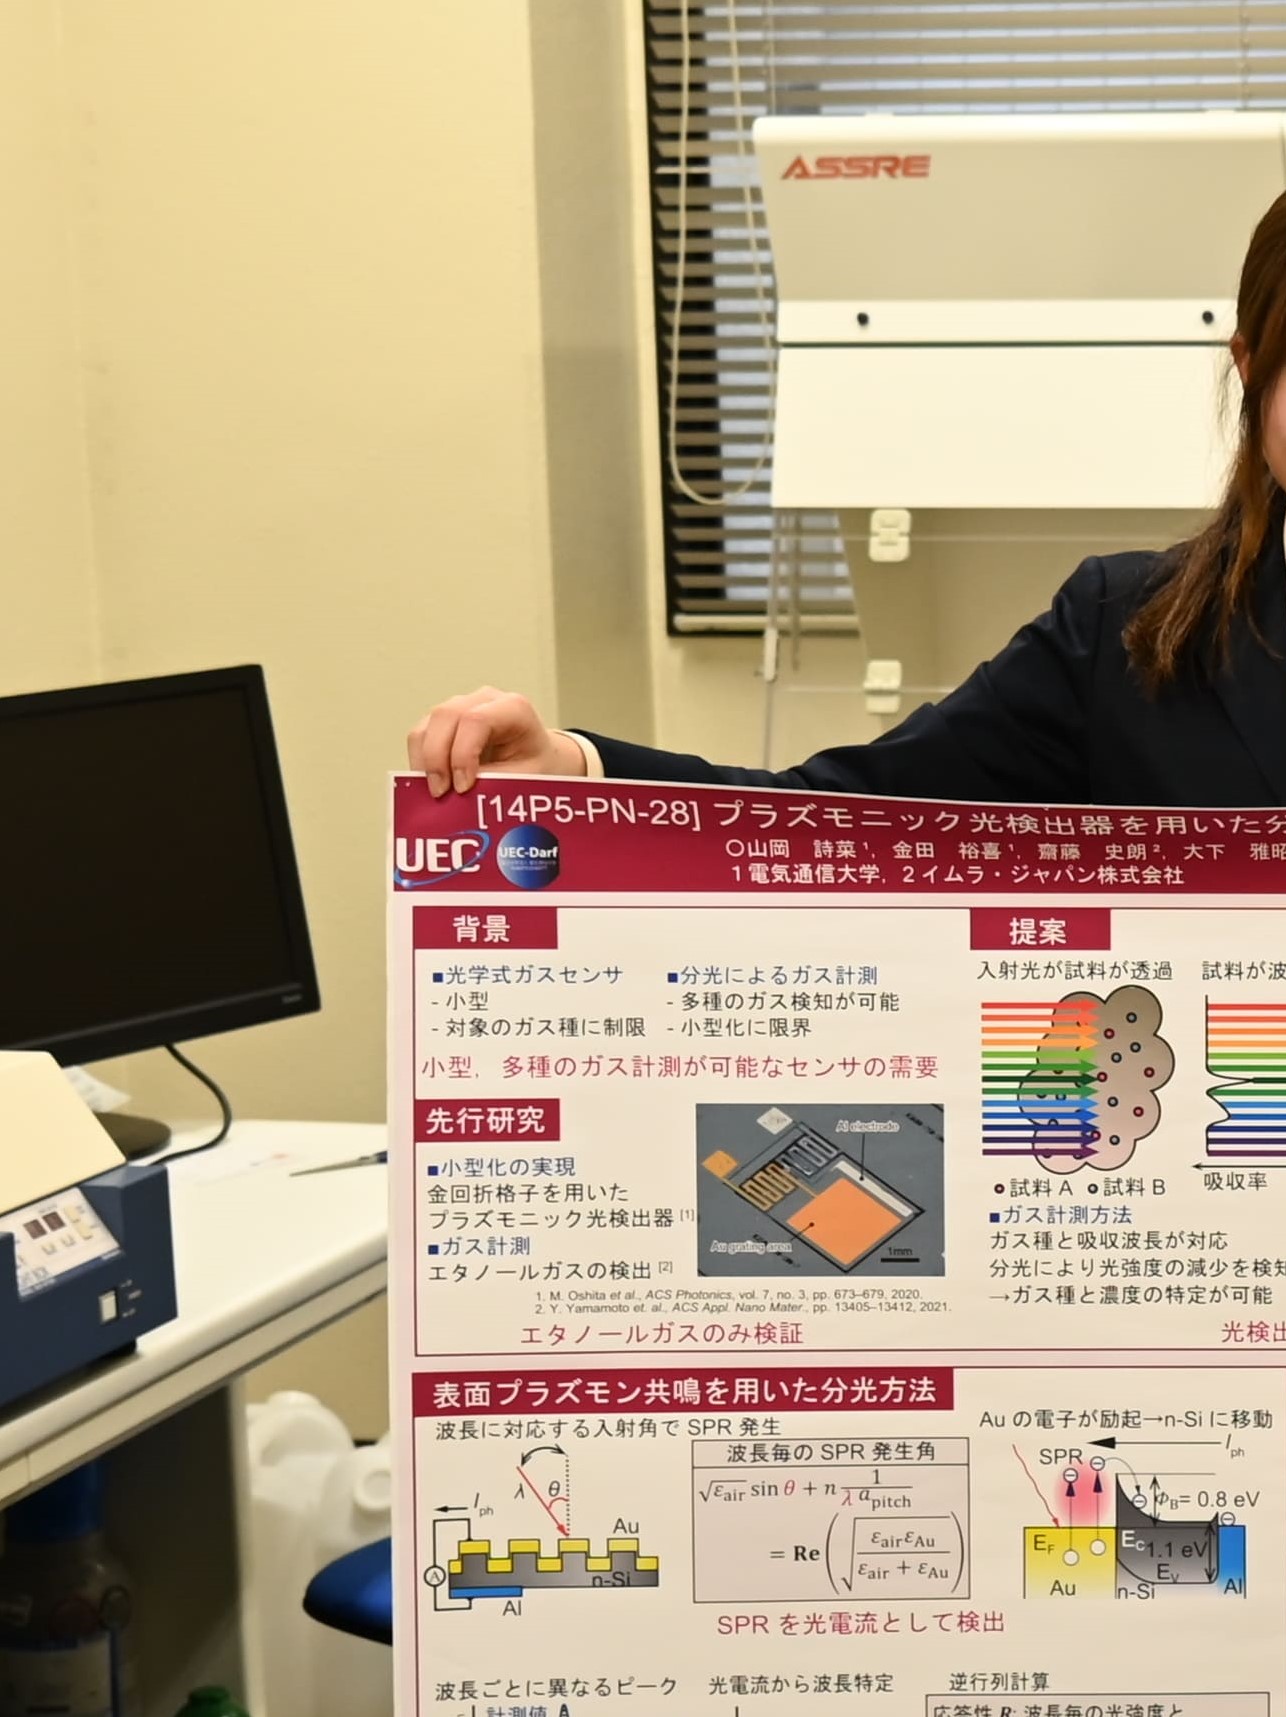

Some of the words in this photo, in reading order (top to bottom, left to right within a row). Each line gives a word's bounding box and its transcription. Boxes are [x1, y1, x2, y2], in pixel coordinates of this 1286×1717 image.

[780, 155, 932, 180] ASSRE
[477, 794, 701, 832] [14P5-PN-28]
[396, 837, 481, 873] UEC
[499, 846, 558, 858] UEC-Darf
[452, 914, 511, 944] 背景
[1009, 917, 1067, 946] 提案
[445, 965, 623, 986] 光学式ガスセンサ
[681, 965, 878, 986] 分光によるガス計測
[977, 960, 1174, 982] 入射光が試料が透過
[681, 991, 900, 1012] 多種のガス検知が可能
[445, 1017, 646, 1038] 対象のガス種に制限
[681, 1017, 812, 1038] 小型化に限界
[426, 1106, 545, 1135] 先行研究
[442, 1157, 576, 1177] 小型化の実現
[1203, 1171, 1268, 1191] 吸収率
[427, 1183, 629, 1204] 金回折格子を用いた
[429, 1208, 674, 1230] プラズモニック光検出器
[1003, 1204, 1132, 1225] ガス計測方法
[442, 1236, 530, 1256] ガス計測
[989, 1231, 1228, 1252] ガス種と吸収波長が対応
[428, 1261, 652, 1282] エタノールガスの検出
[568, 1290, 606, 1301] Oshita
[645, 1289, 672, 1300] ACS
[565, 1303, 630, 1314] Yamamoto
[520, 1322, 804, 1346] エタノールガスのみ検証
[432, 1375, 937, 1410] 表面プラズモン共鳴を用いた分光方法
[1039, 1448, 1083, 1466] SPR
[612, 1518, 640, 1535] Au
[1050, 1580, 1076, 1596] Au
[717, 1615, 770, 1635] SPR
[435, 1677, 677, 1701] 波長ごとに異なるピーク
[708, 1673, 894, 1696] 光電流から波長特定
[949, 1672, 1050, 1692] 逆行列計算
